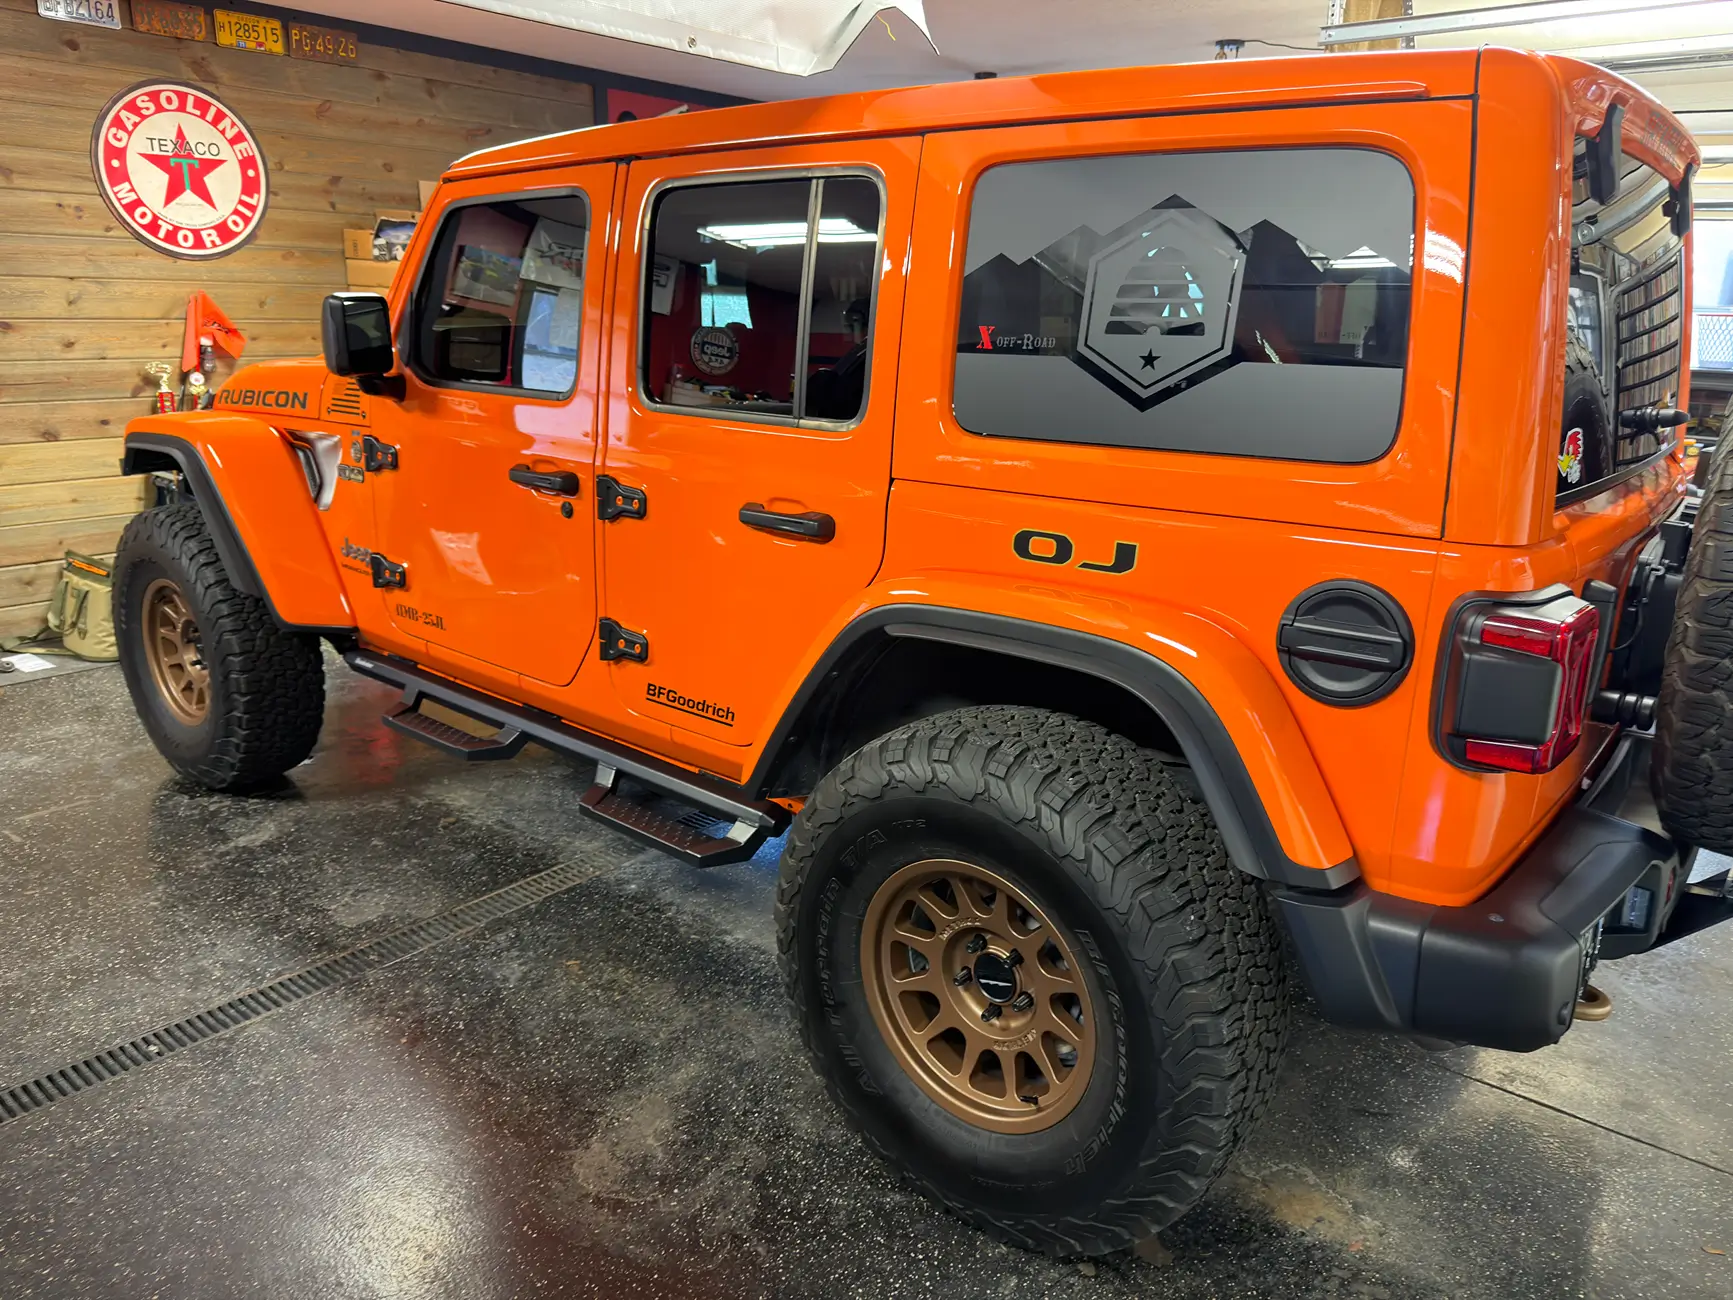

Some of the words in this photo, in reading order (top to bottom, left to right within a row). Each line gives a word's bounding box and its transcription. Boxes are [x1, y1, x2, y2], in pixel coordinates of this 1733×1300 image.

[218, 21, 280, 44] H128515
[107, 91, 254, 161] GASOLINE
[146, 137, 221, 157] TEXACO
[112, 181, 223, 249] MOTOR
[226, 193, 260, 233] OIL
[976, 325, 996, 350] X
[217, 388, 308, 410] RUBICON
[646, 682, 735, 722] BFGoodrich
